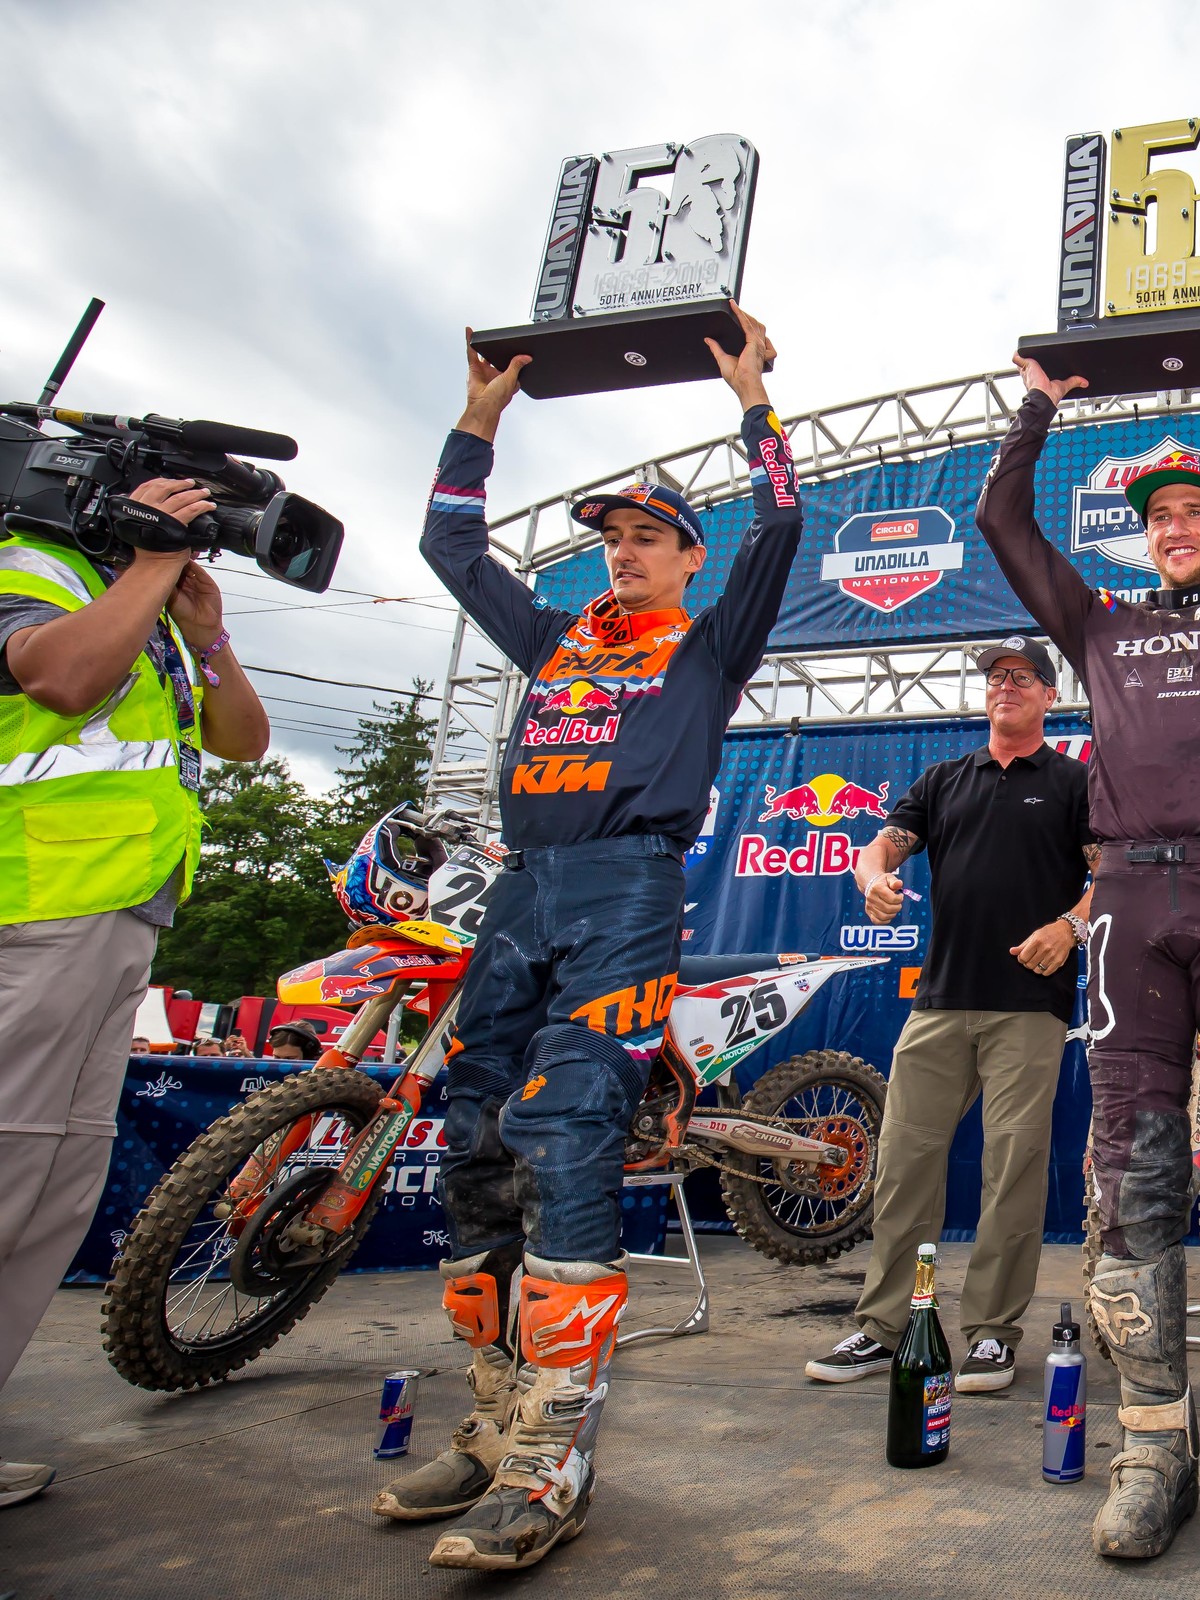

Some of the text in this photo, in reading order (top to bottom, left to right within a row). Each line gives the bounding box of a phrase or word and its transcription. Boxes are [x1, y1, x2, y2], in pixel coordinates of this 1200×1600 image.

[599, 283, 702, 306] 50TH ANNIVERSARY
[1136, 290, 1165, 304] 50TH
[759, 437, 796, 507] Red Bull
[875, 526, 902, 535] CIRCLE
[852, 574, 930, 588] NATIONAL
[522, 714, 621, 746] Red Bull
[511, 754, 613, 795] KTM
[468, 855, 502, 872] LUCA
[735, 831, 820, 877] Red
[840, 924, 919, 951] WPS
[570, 971, 679, 1035] THO
[720, 982, 788, 1049] 25
[721, 1041, 757, 1062] MOTOREX
[366, 1110, 413, 1171] MOTOREX
[393, 1403, 411, 1415] Bull
[1051, 1404, 1074, 1417] Red
